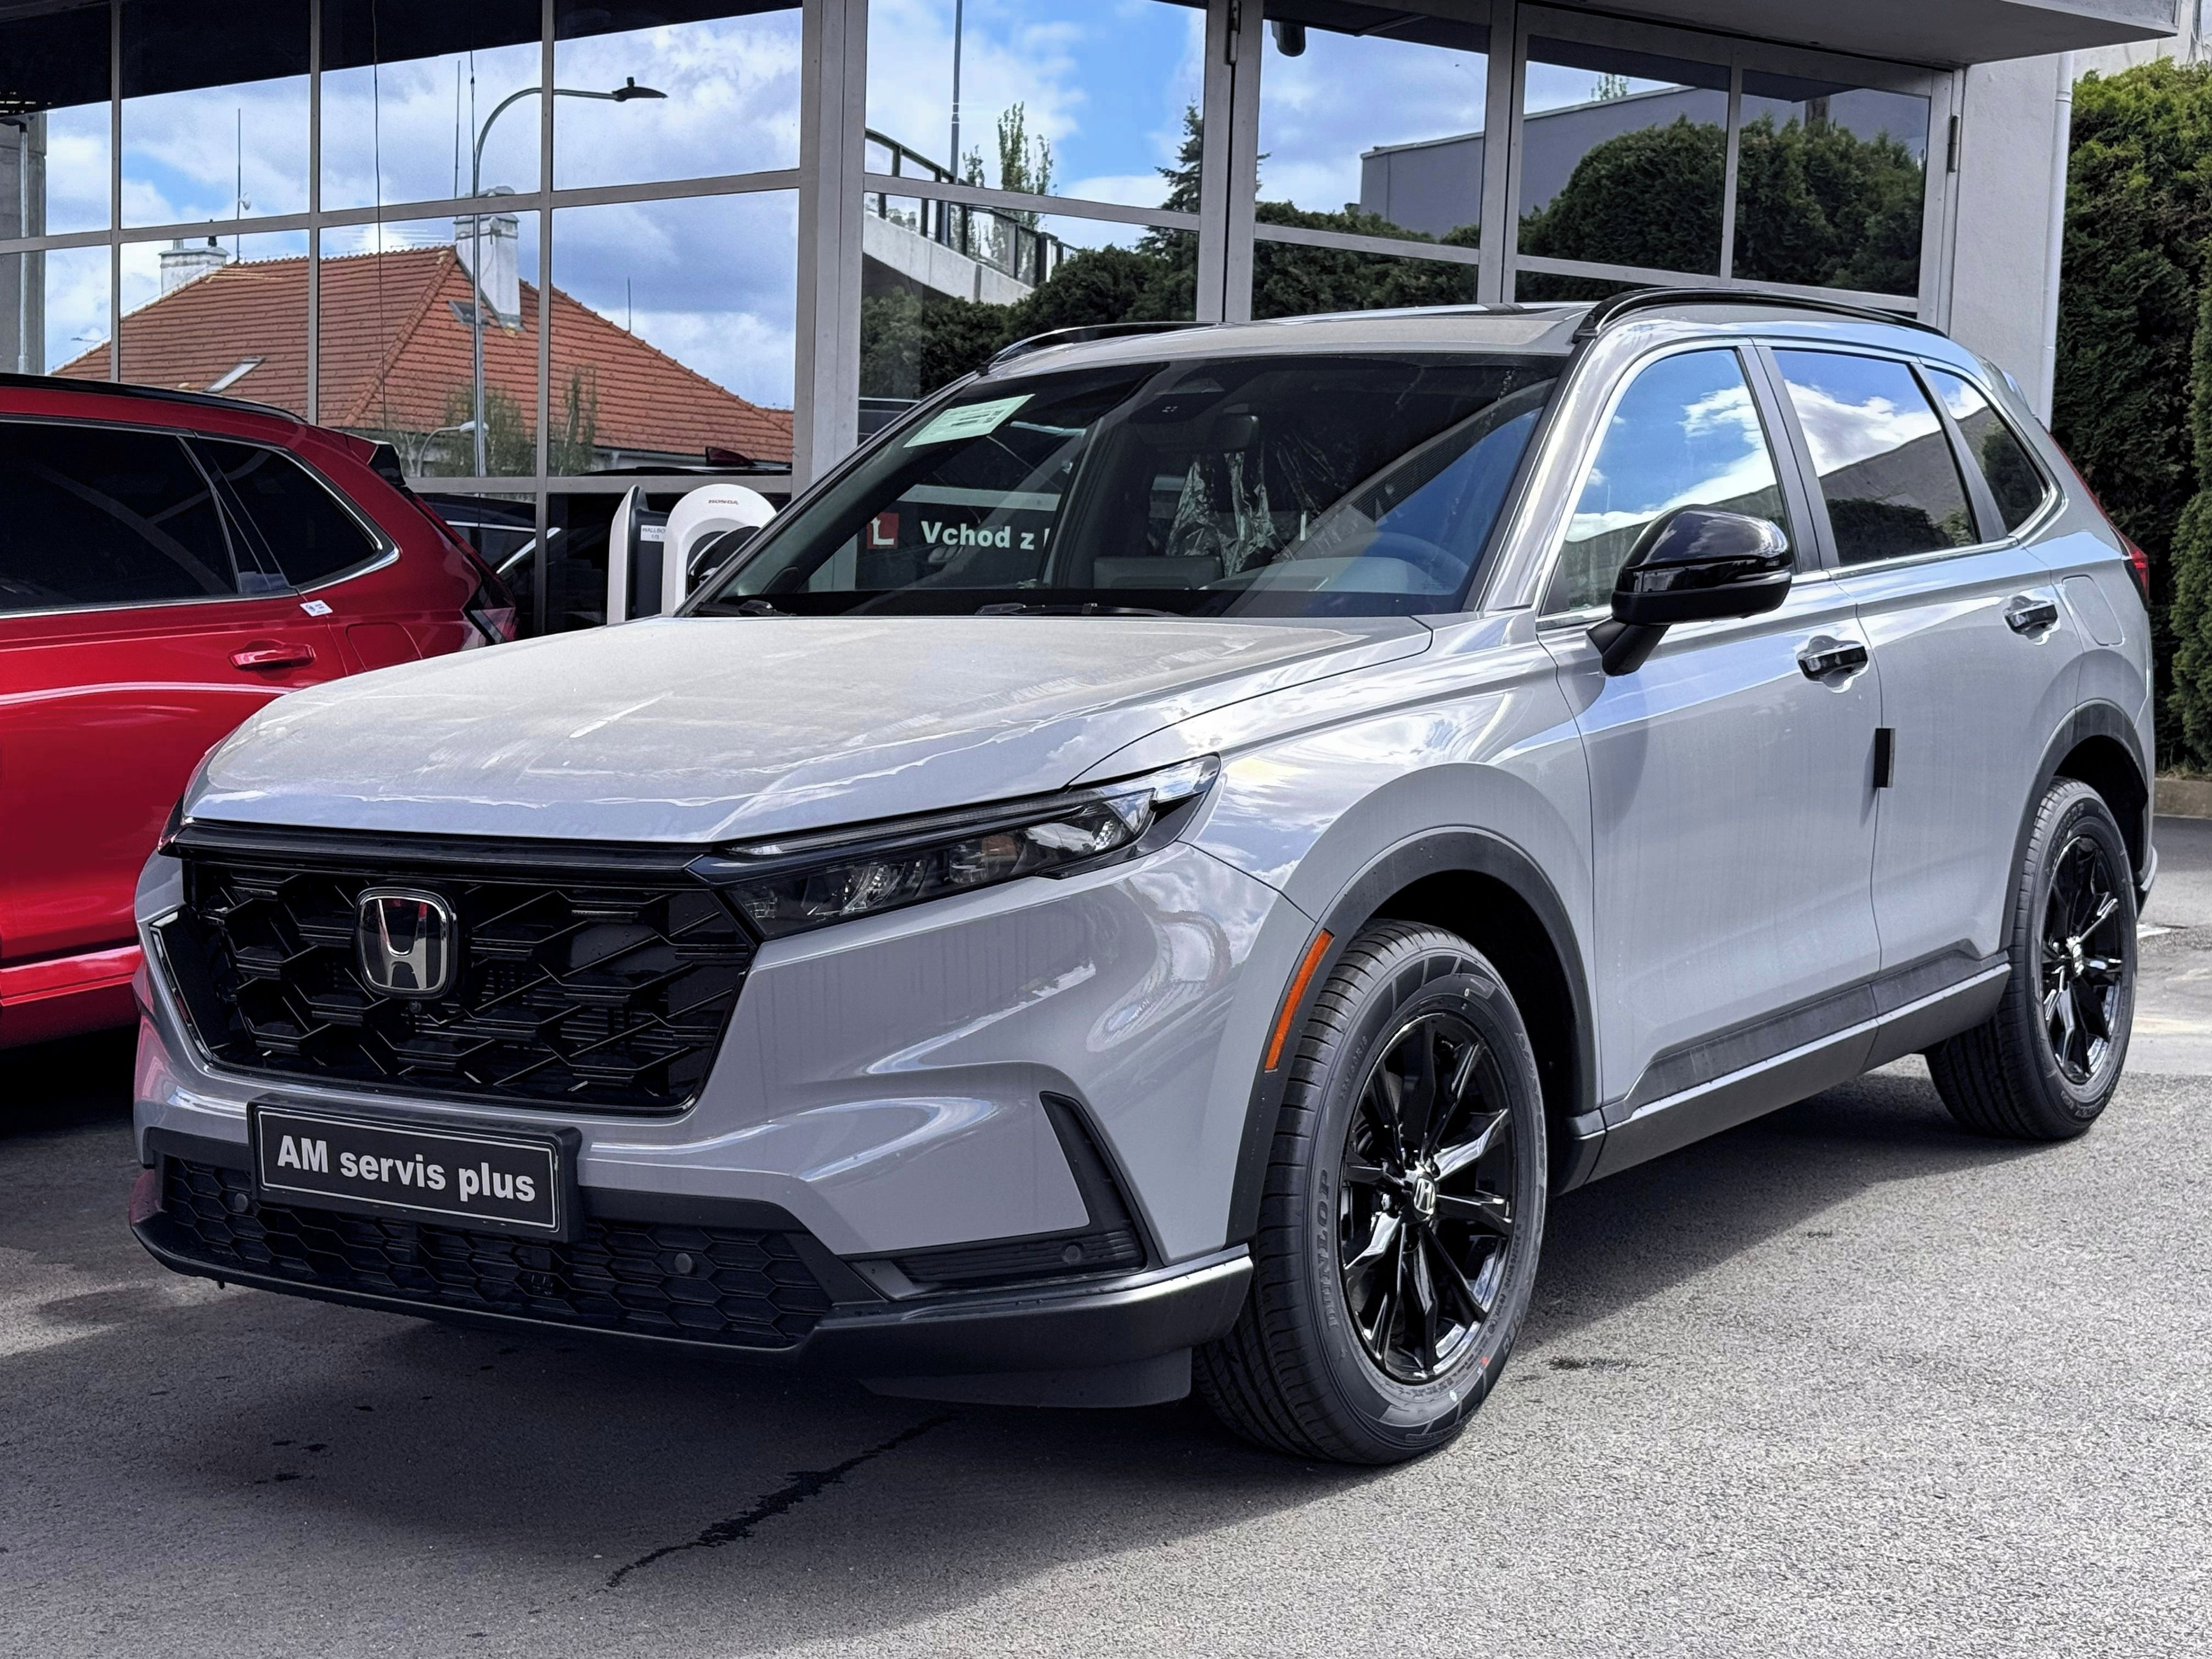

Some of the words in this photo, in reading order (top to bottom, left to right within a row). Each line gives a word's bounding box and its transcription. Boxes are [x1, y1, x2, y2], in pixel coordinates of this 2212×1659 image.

[921, 520, 1011, 548] Vchod
[1020, 532, 1034, 550] z
[277, 1135, 329, 1173] AM
[340, 1154, 446, 1190] servis
[459, 1163, 535, 1201] plus
[1316, 1169, 1340, 1331] DUNLOP
